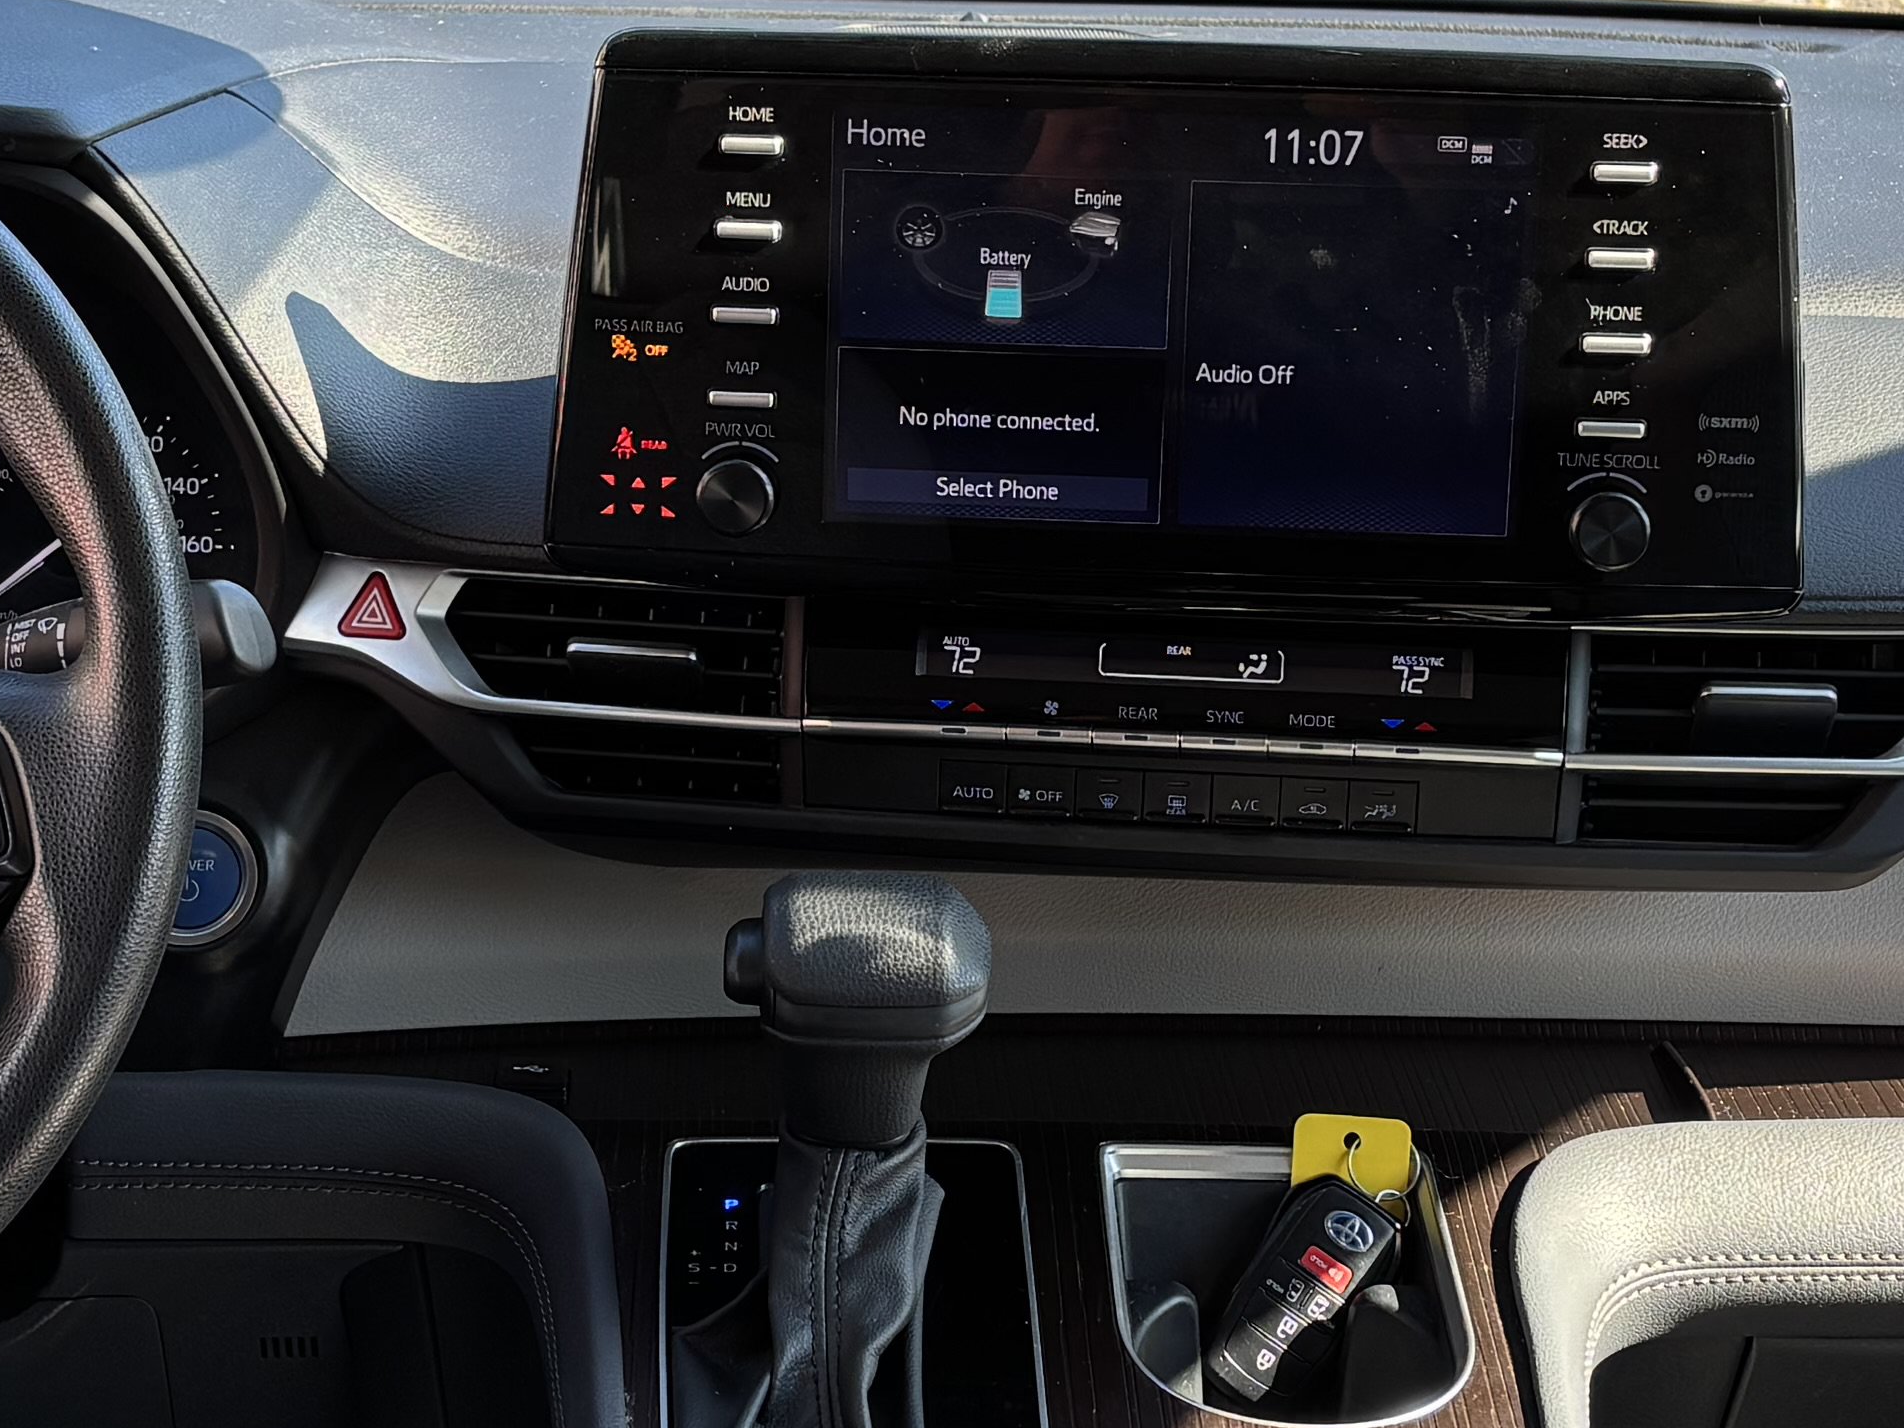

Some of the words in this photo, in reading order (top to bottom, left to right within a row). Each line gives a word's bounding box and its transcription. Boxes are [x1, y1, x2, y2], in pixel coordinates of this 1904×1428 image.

[728, 106, 775, 123] HOME
[847, 118, 927, 149] Home
[1263, 129, 1364, 166] 11:07
[725, 191, 772, 208] MENU
[1074, 188, 1123, 210] Engine
[979, 247, 1031, 270] Battery
[721, 276, 770, 294] AUDIO
[1590, 305, 1643, 323] PHONE
[594, 318, 628, 332] PASS
[630, 319, 654, 333] AIR
[656, 320, 684, 334] BAG
[644, 344, 669, 356] OFF
[725, 360, 760, 375] MAP
[1196, 364, 1254, 384] Audio
[1259, 364, 1295, 385] Off
[1593, 390, 1630, 407] APPS
[899, 405, 928, 427] No
[932, 407, 992, 432] phone
[995, 409, 1101, 433] connected.
[705, 421, 742, 437] PWR
[744, 423, 777, 438] VOL
[1557, 452, 1601, 470] TUNE
[1603, 453, 1662, 471] SCROLL
[1718, 452, 1756, 466] Radio
[163, 476, 200, 495] 140
[935, 477, 995, 499] Select
[997, 478, 1060, 501] Phone
[178, 535, 214, 554] 160
[11, 630, 30, 642] OFF
[942, 636, 970, 646] AUTO
[1166, 645, 1192, 656] REAR
[943, 645, 982, 675] 72
[1392, 655, 1418, 665] PASS
[1419, 656, 1445, 667] SYNC
[1392, 665, 1430, 694] 72
[1118, 705, 1158, 721] REAR
[1205, 708, 1245, 725] SYNC
[1289, 712, 1336, 729] MODE
[953, 784, 994, 800] AUTO
[1036, 787, 1064, 803] OFF
[1231, 799, 1261, 813] A/C
[724, 1198, 739, 1210] P
[725, 1220, 738, 1230] R
[724, 1241, 738, 1251] N
[723, 1263, 737, 1273] D
